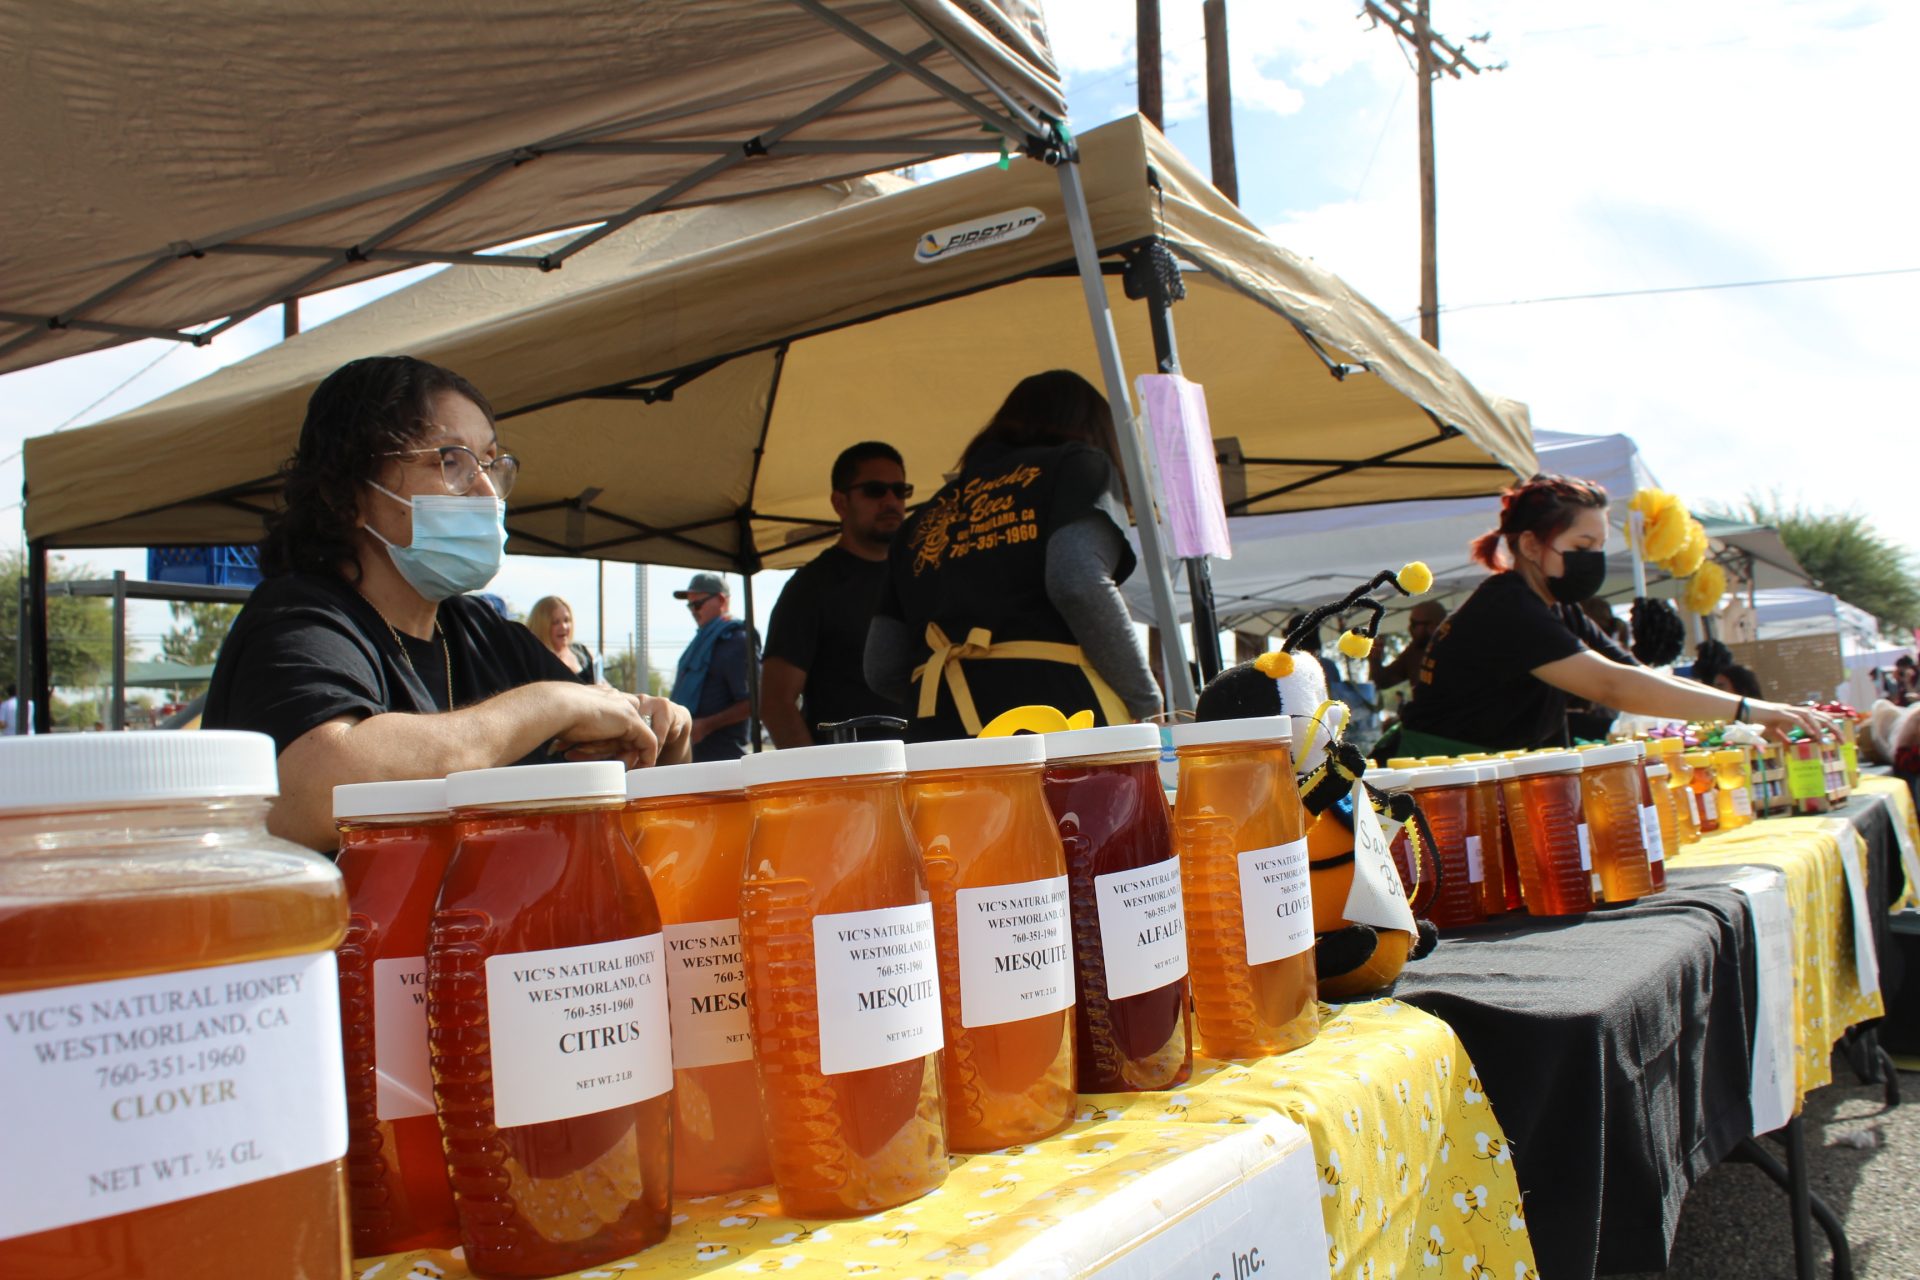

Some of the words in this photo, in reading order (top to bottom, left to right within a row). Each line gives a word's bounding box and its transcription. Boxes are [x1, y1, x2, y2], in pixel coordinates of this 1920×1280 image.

[1021, 508, 1035, 522] CA
[1113, 881, 1138, 895] VIC'S
[1139, 872, 1170, 890] NATURAL
[977, 899, 1007, 913] VIC'S
[1009, 893, 1050, 910] NATURAL
[1276, 895, 1311, 918] CLOVER
[838, 928, 871, 942] VIC'S
[873, 922, 915, 940] NATURAL
[1012, 927, 1057, 944] 760-351-1960
[1137, 917, 1183, 947] ALFALFA
[669, 937, 707, 951] VIC'S
[513, 967, 556, 984] VIC'S
[559, 958, 622, 978] NATURAL
[624, 950, 656, 968] HONEY
[682, 952, 744, 969] WESTMO
[877, 960, 923, 978] 760-351-1960
[994, 943, 1067, 974] MESQUITE
[400, 972, 426, 986] VIC
[529, 976, 638, 1004] WESTMORLAND,
[639, 973, 652, 986] CA
[5, 1003, 83, 1035] VIC'S
[91, 986, 218, 1023] NATURAL
[225, 972, 305, 1004] HONEY
[857, 979, 933, 1012] MESQUITE
[1020, 991, 1033, 1000] NET
[564, 997, 634, 1021] 760-351-1960
[34, 1012, 251, 1066] WESTMORLAND,
[257, 1006, 290, 1030] CA
[559, 1020, 641, 1054] CITRUS
[726, 1034, 744, 1044] NET
[886, 1031, 900, 1042] NET
[95, 1045, 247, 1089] 760-351-1960
[576, 1079, 596, 1091] NET
[598, 1075, 614, 1086] WT.
[616, 1073, 621, 1082] 2
[622, 1070, 633, 1081] LB
[111, 1079, 237, 1123] CLOVER
[88, 1164, 146, 1198] NET
[152, 1153, 200, 1184] WT.
[231, 1140, 263, 1165] GL
[1231, 1247, 1265, 1280] Inc.
